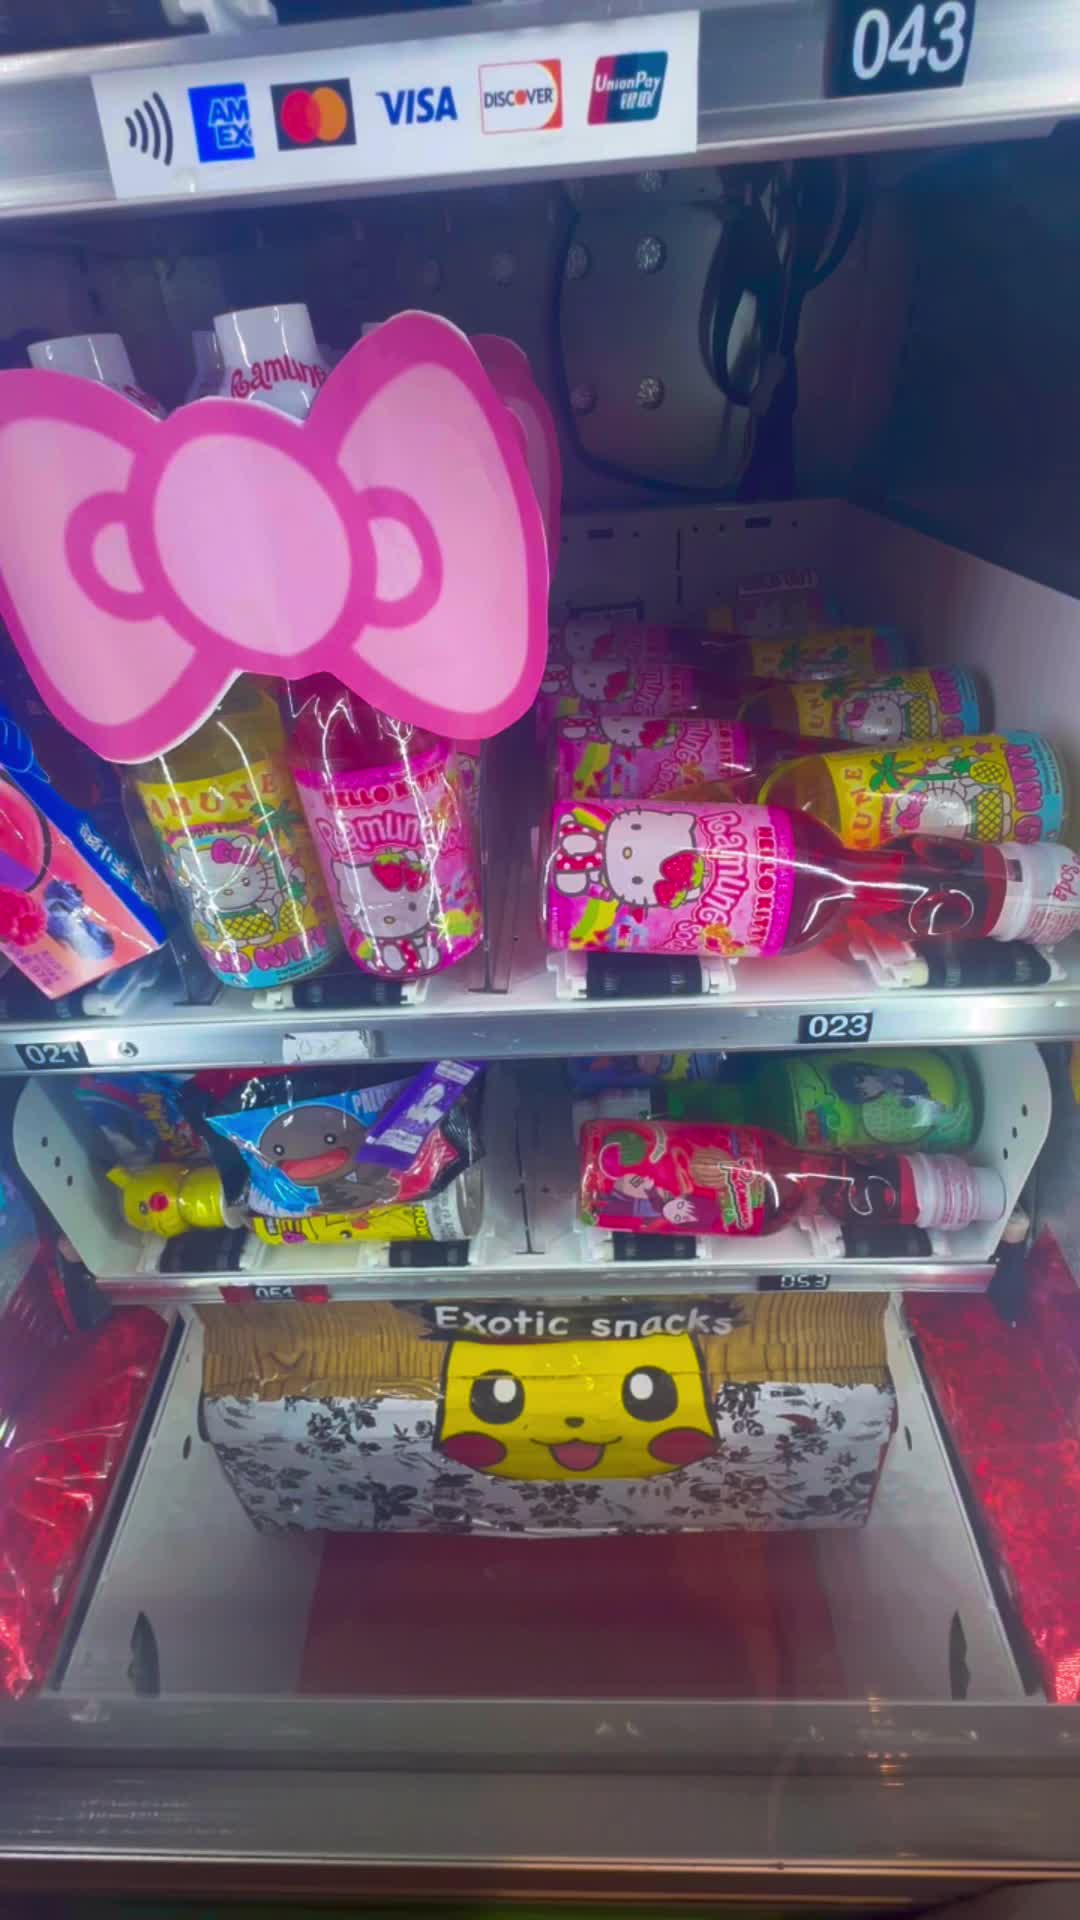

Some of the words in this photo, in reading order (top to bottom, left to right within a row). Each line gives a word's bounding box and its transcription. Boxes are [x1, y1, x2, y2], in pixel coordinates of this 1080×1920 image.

[853, 2, 966, 80] 043
[595, 70, 661, 96] UnionPay
[208, 96, 250, 125] AM
[376, 86, 457, 125] VISA
[484, 87, 553, 109] DISCOVER
[216, 123, 254, 149] EX
[322, 785, 391, 807] HELLO
[697, 810, 748, 926] Ramune
[757, 825, 776, 892] HELLO
[808, 1015, 868, 1038] 023
[24, 1042, 81, 1065] 021
[781, 1273, 828, 1289] 053
[434, 1305, 569, 1336] Exotic
[591, 1307, 733, 1338] snacks
